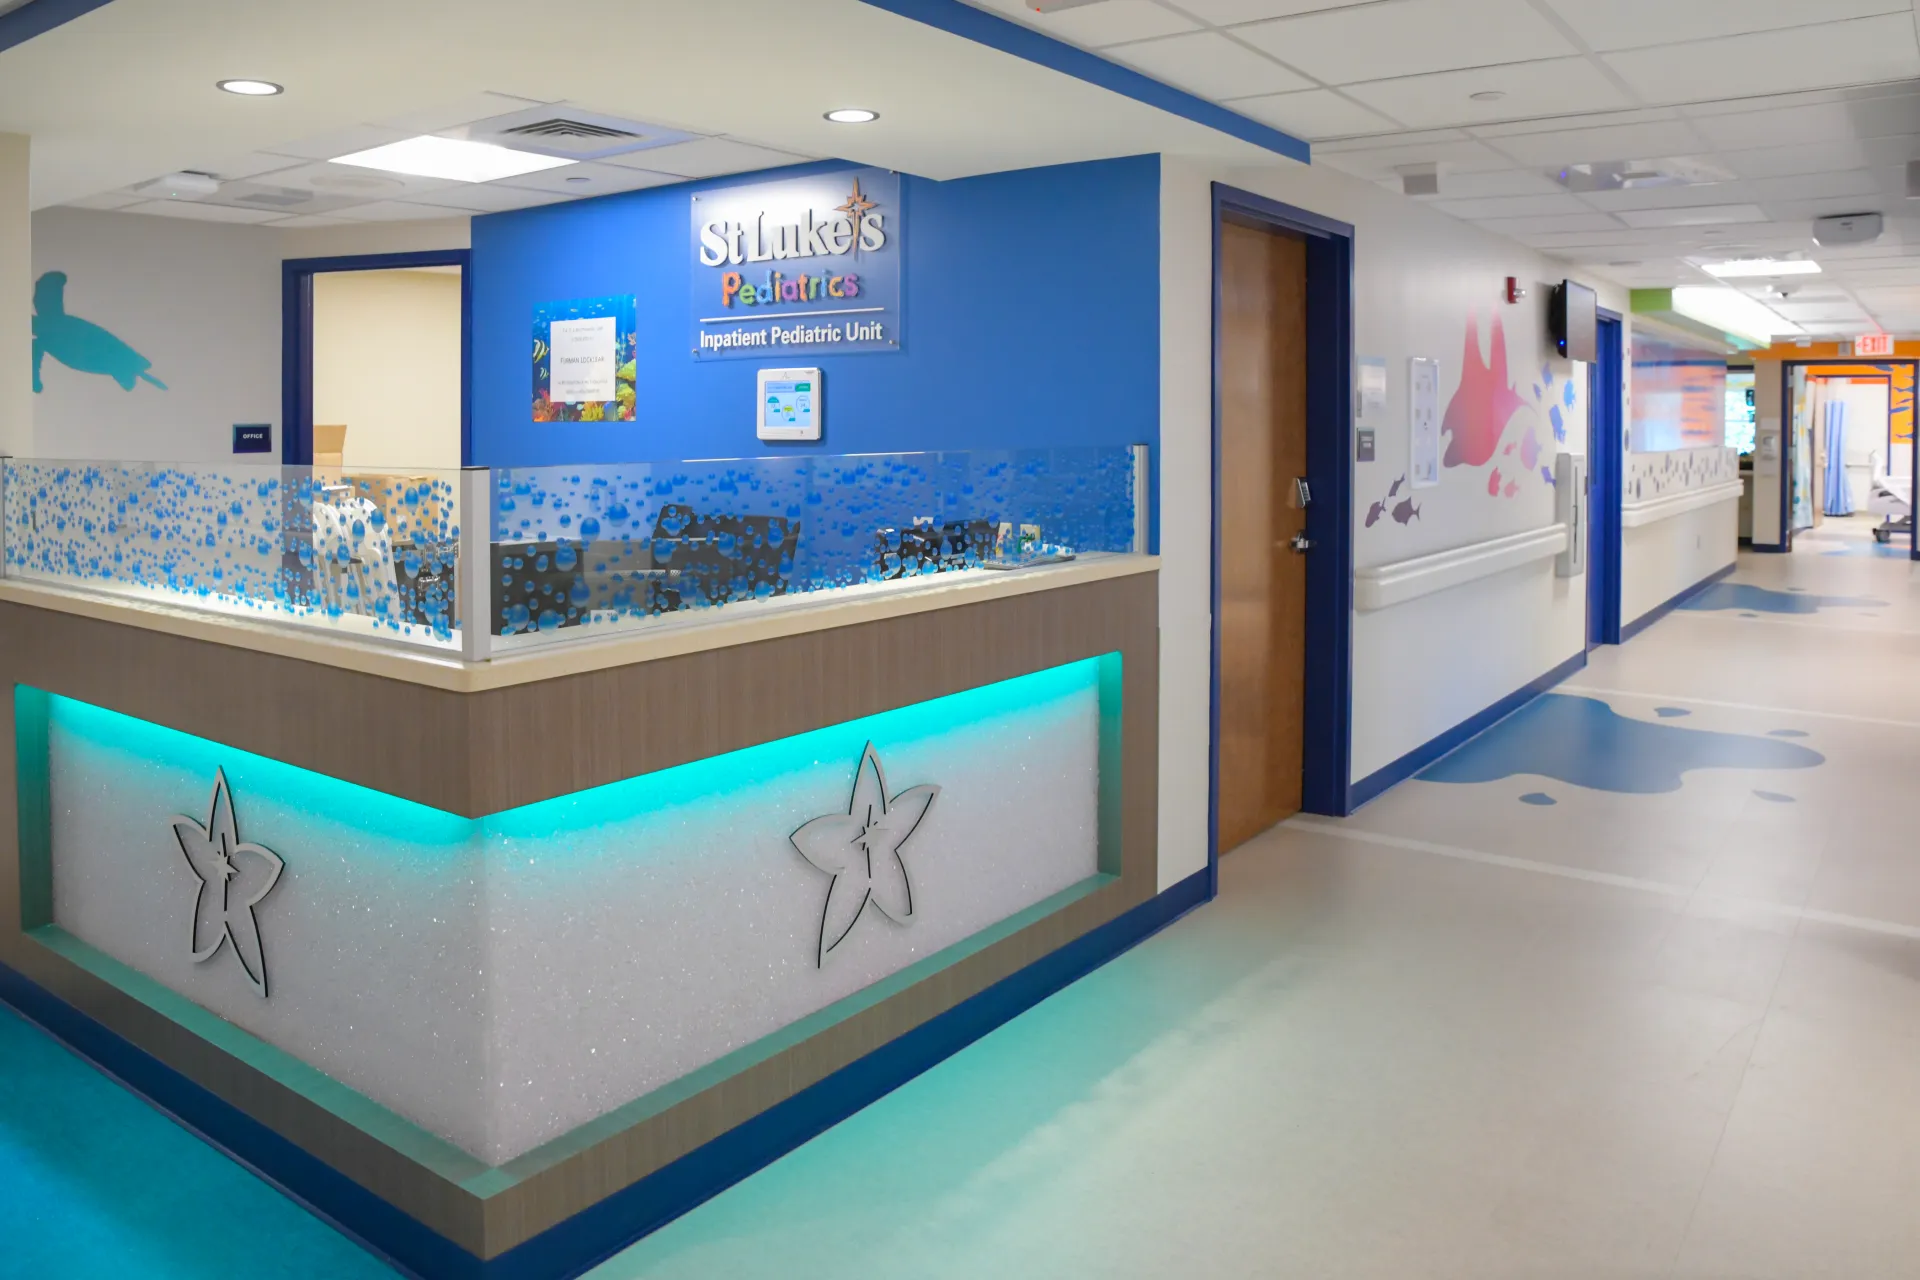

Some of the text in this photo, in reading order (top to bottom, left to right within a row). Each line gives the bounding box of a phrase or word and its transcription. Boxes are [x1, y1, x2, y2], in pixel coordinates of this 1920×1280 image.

[699, 219, 744, 267] St
[721, 269, 861, 309] Pediatrics
[700, 321, 883, 352] Inpatient Pediatric Unit
[1862, 335, 1888, 353] EXIT
